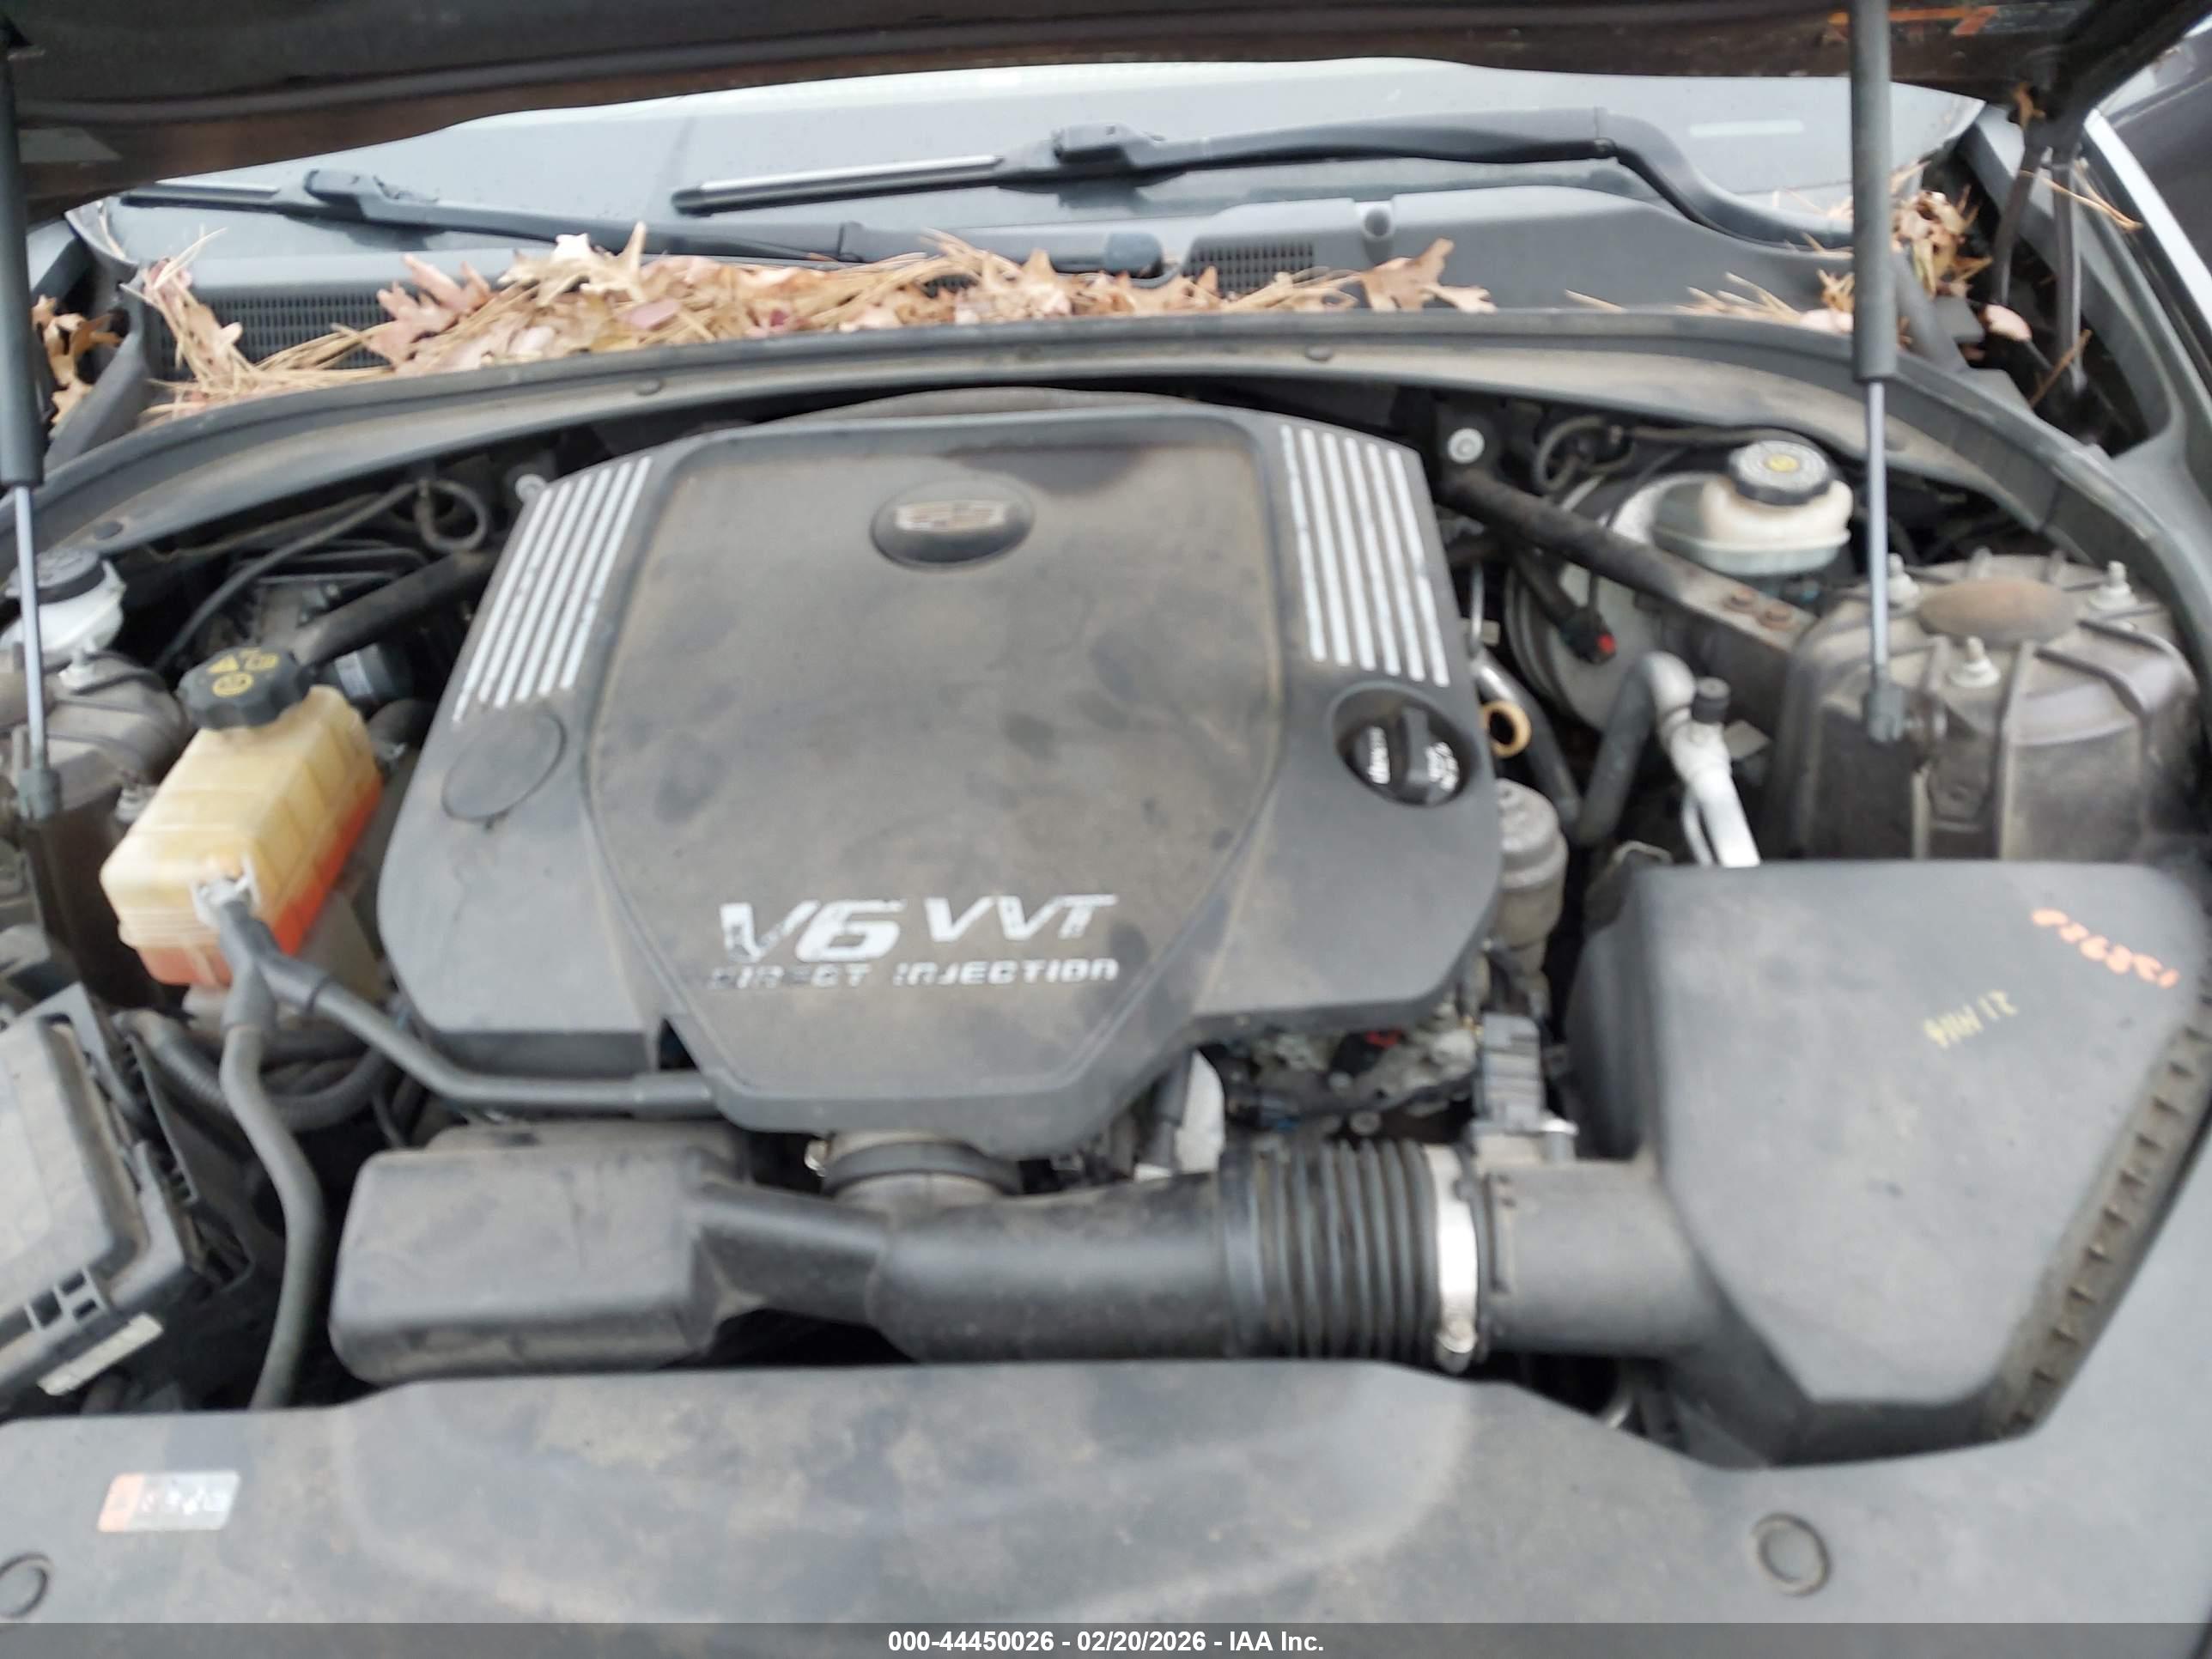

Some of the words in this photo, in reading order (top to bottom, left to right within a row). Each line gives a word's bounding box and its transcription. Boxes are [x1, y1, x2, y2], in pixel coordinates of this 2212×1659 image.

[720, 899, 907, 963] V6
[925, 894, 1118, 942] VVT
[892, 957, 1120, 987] INJECTION
